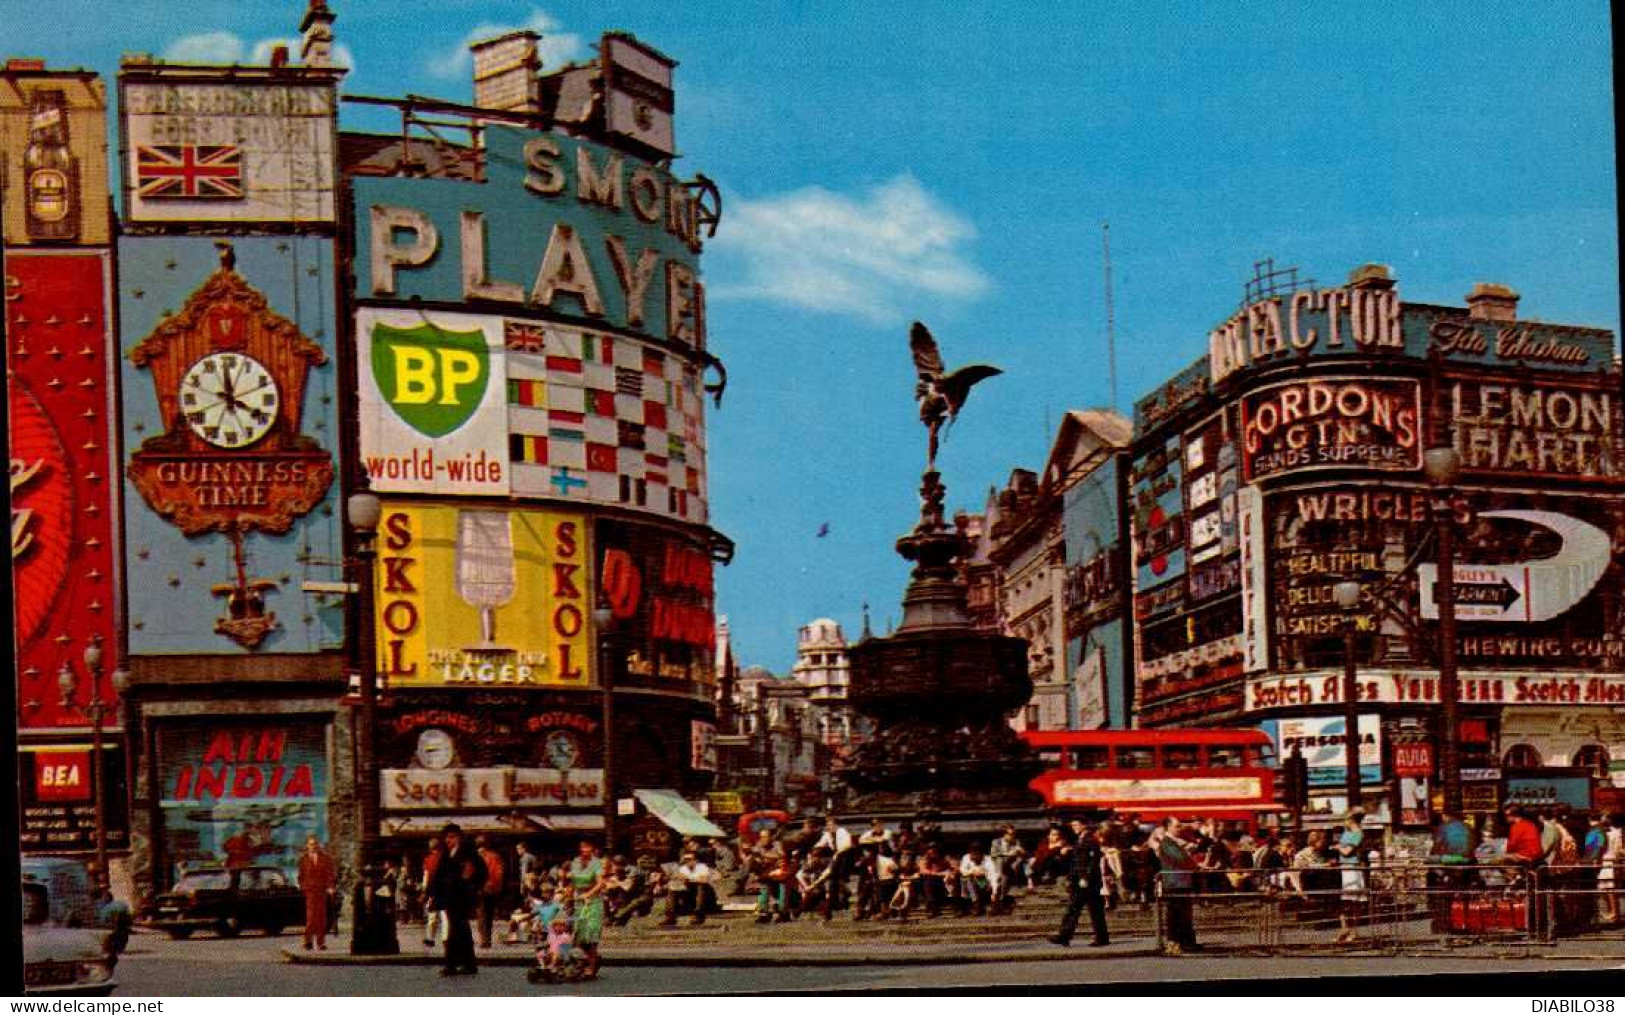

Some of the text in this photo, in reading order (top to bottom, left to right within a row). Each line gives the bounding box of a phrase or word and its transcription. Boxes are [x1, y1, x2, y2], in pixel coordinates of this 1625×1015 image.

[370, 204, 705, 350] PLAYE
[1248, 287, 1405, 361] FACTOR
[389, 344, 481, 406] BP
[1451, 382, 1611, 432] LEMON
[1286, 418, 1358, 449] GIN
[1469, 426, 1596, 475] HART
[366, 447, 502, 483] world-wide
[1317, 444, 1407, 462] SUPREME
[157, 462, 308, 483] GUINNESS
[194, 485, 268, 506] TIME
[383, 511, 419, 679] SKOL
[553, 521, 583, 680] SKOL
[1455, 637, 1562, 657] HEWING
[443, 662, 537, 683] LAGER
[1252, 676, 1313, 708] Scotch
[1321, 674, 1380, 702] Aes
[1515, 676, 1580, 702] Scotch
[527, 710, 598, 732] ROTARY
[203, 729, 287, 763] AIR
[42, 764, 79, 786] BEA
[174, 763, 315, 800] INDIA
